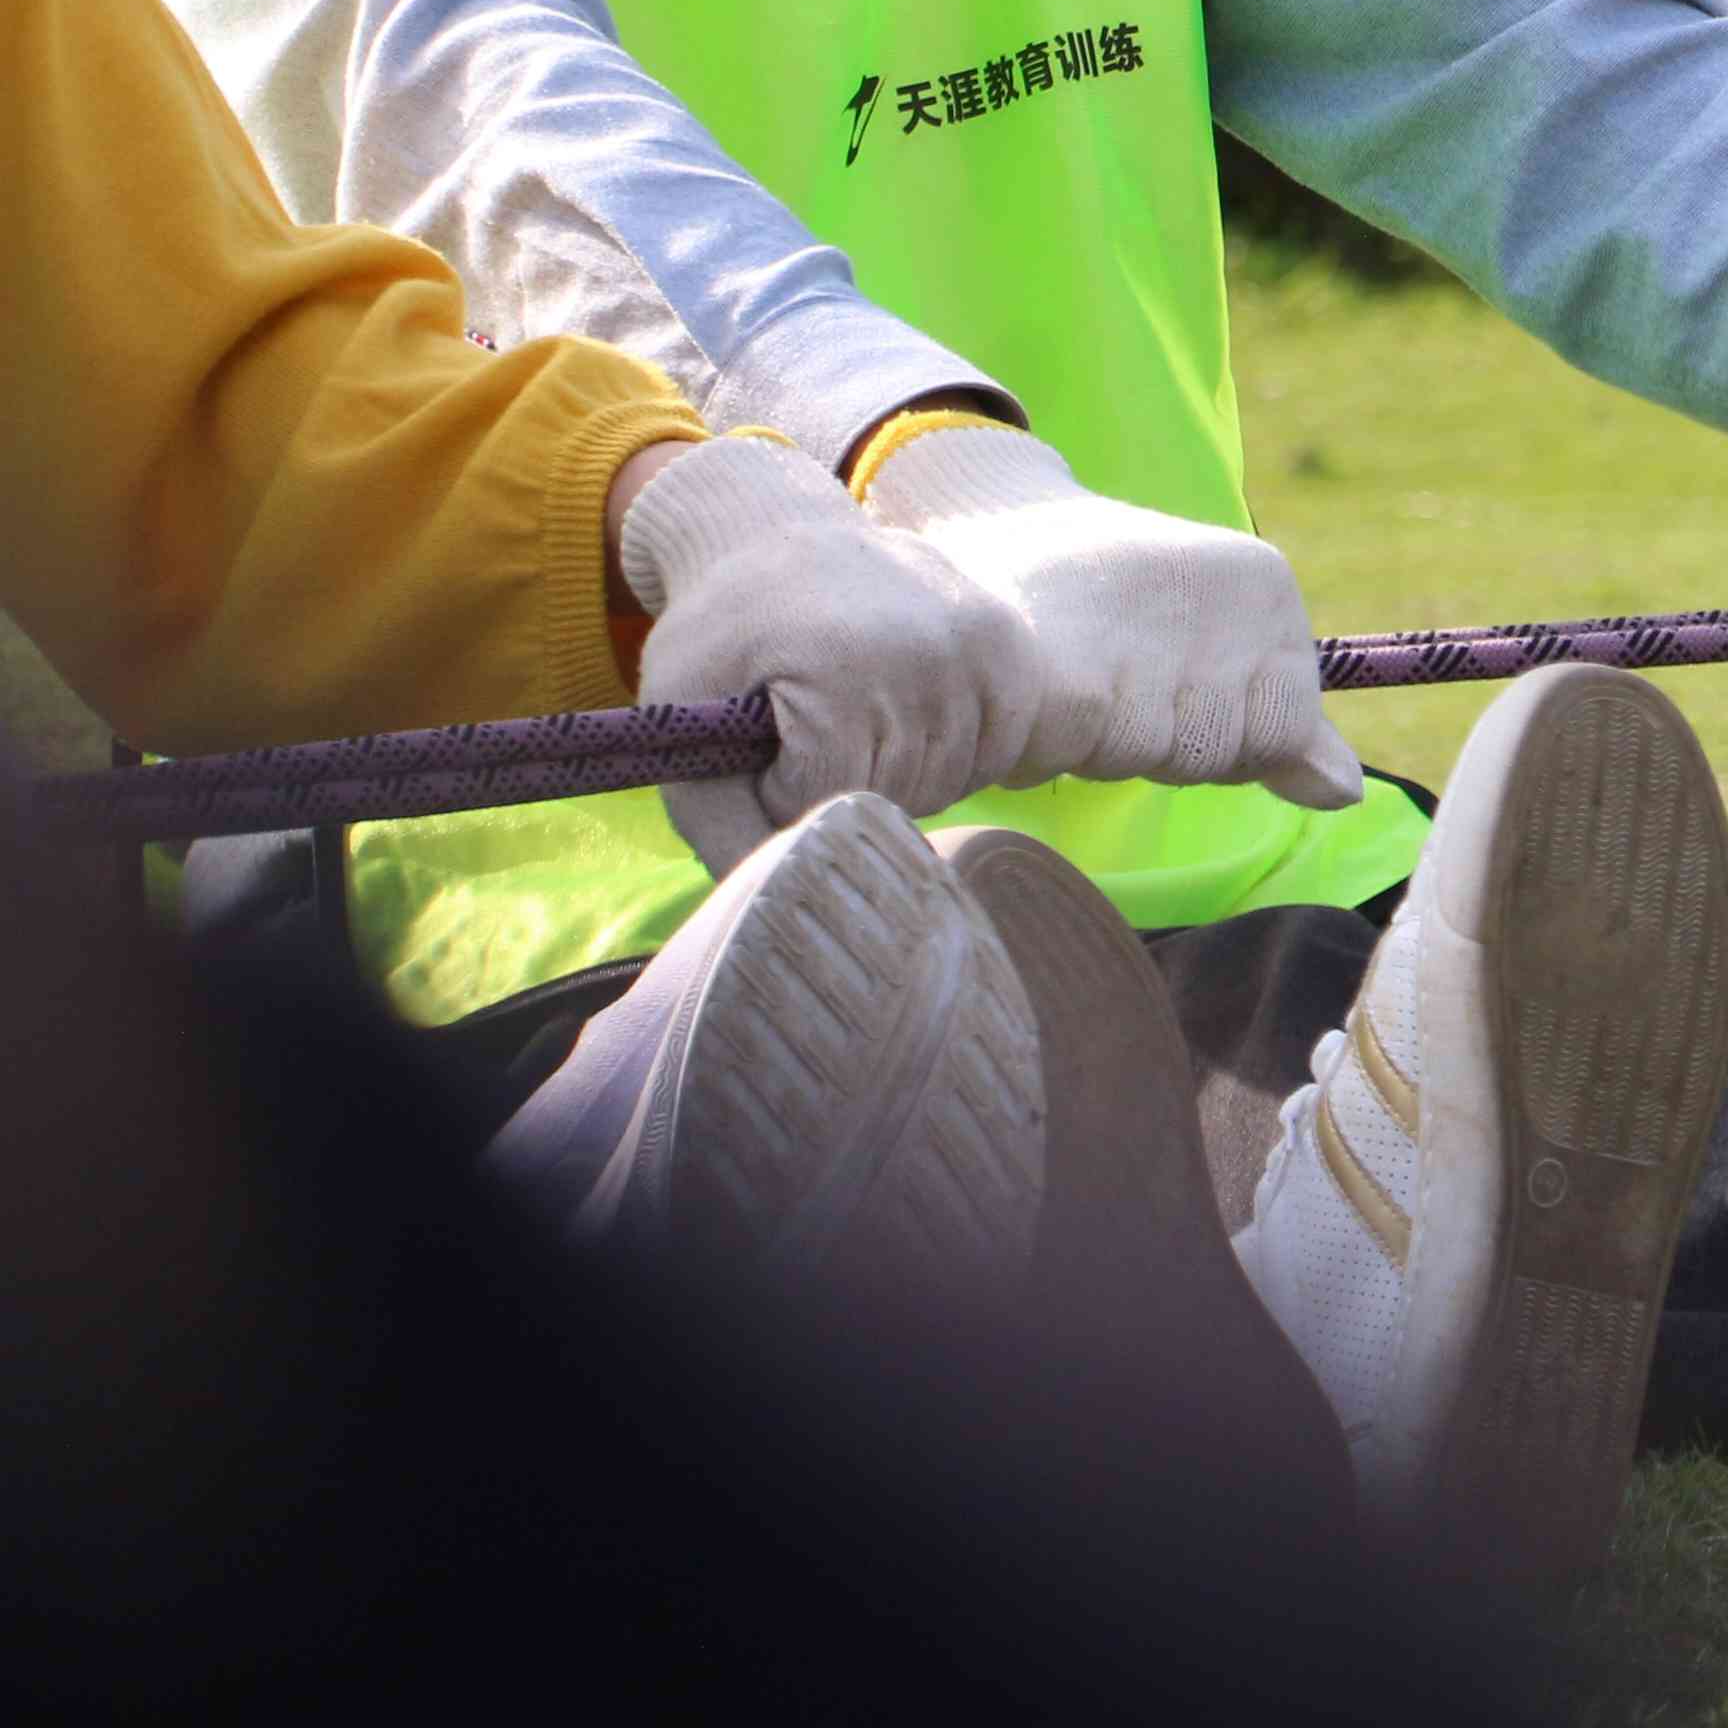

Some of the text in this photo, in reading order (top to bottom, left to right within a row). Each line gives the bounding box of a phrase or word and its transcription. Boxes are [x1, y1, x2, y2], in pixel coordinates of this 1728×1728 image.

[896, 21, 1145, 135] 天涯教育训练
